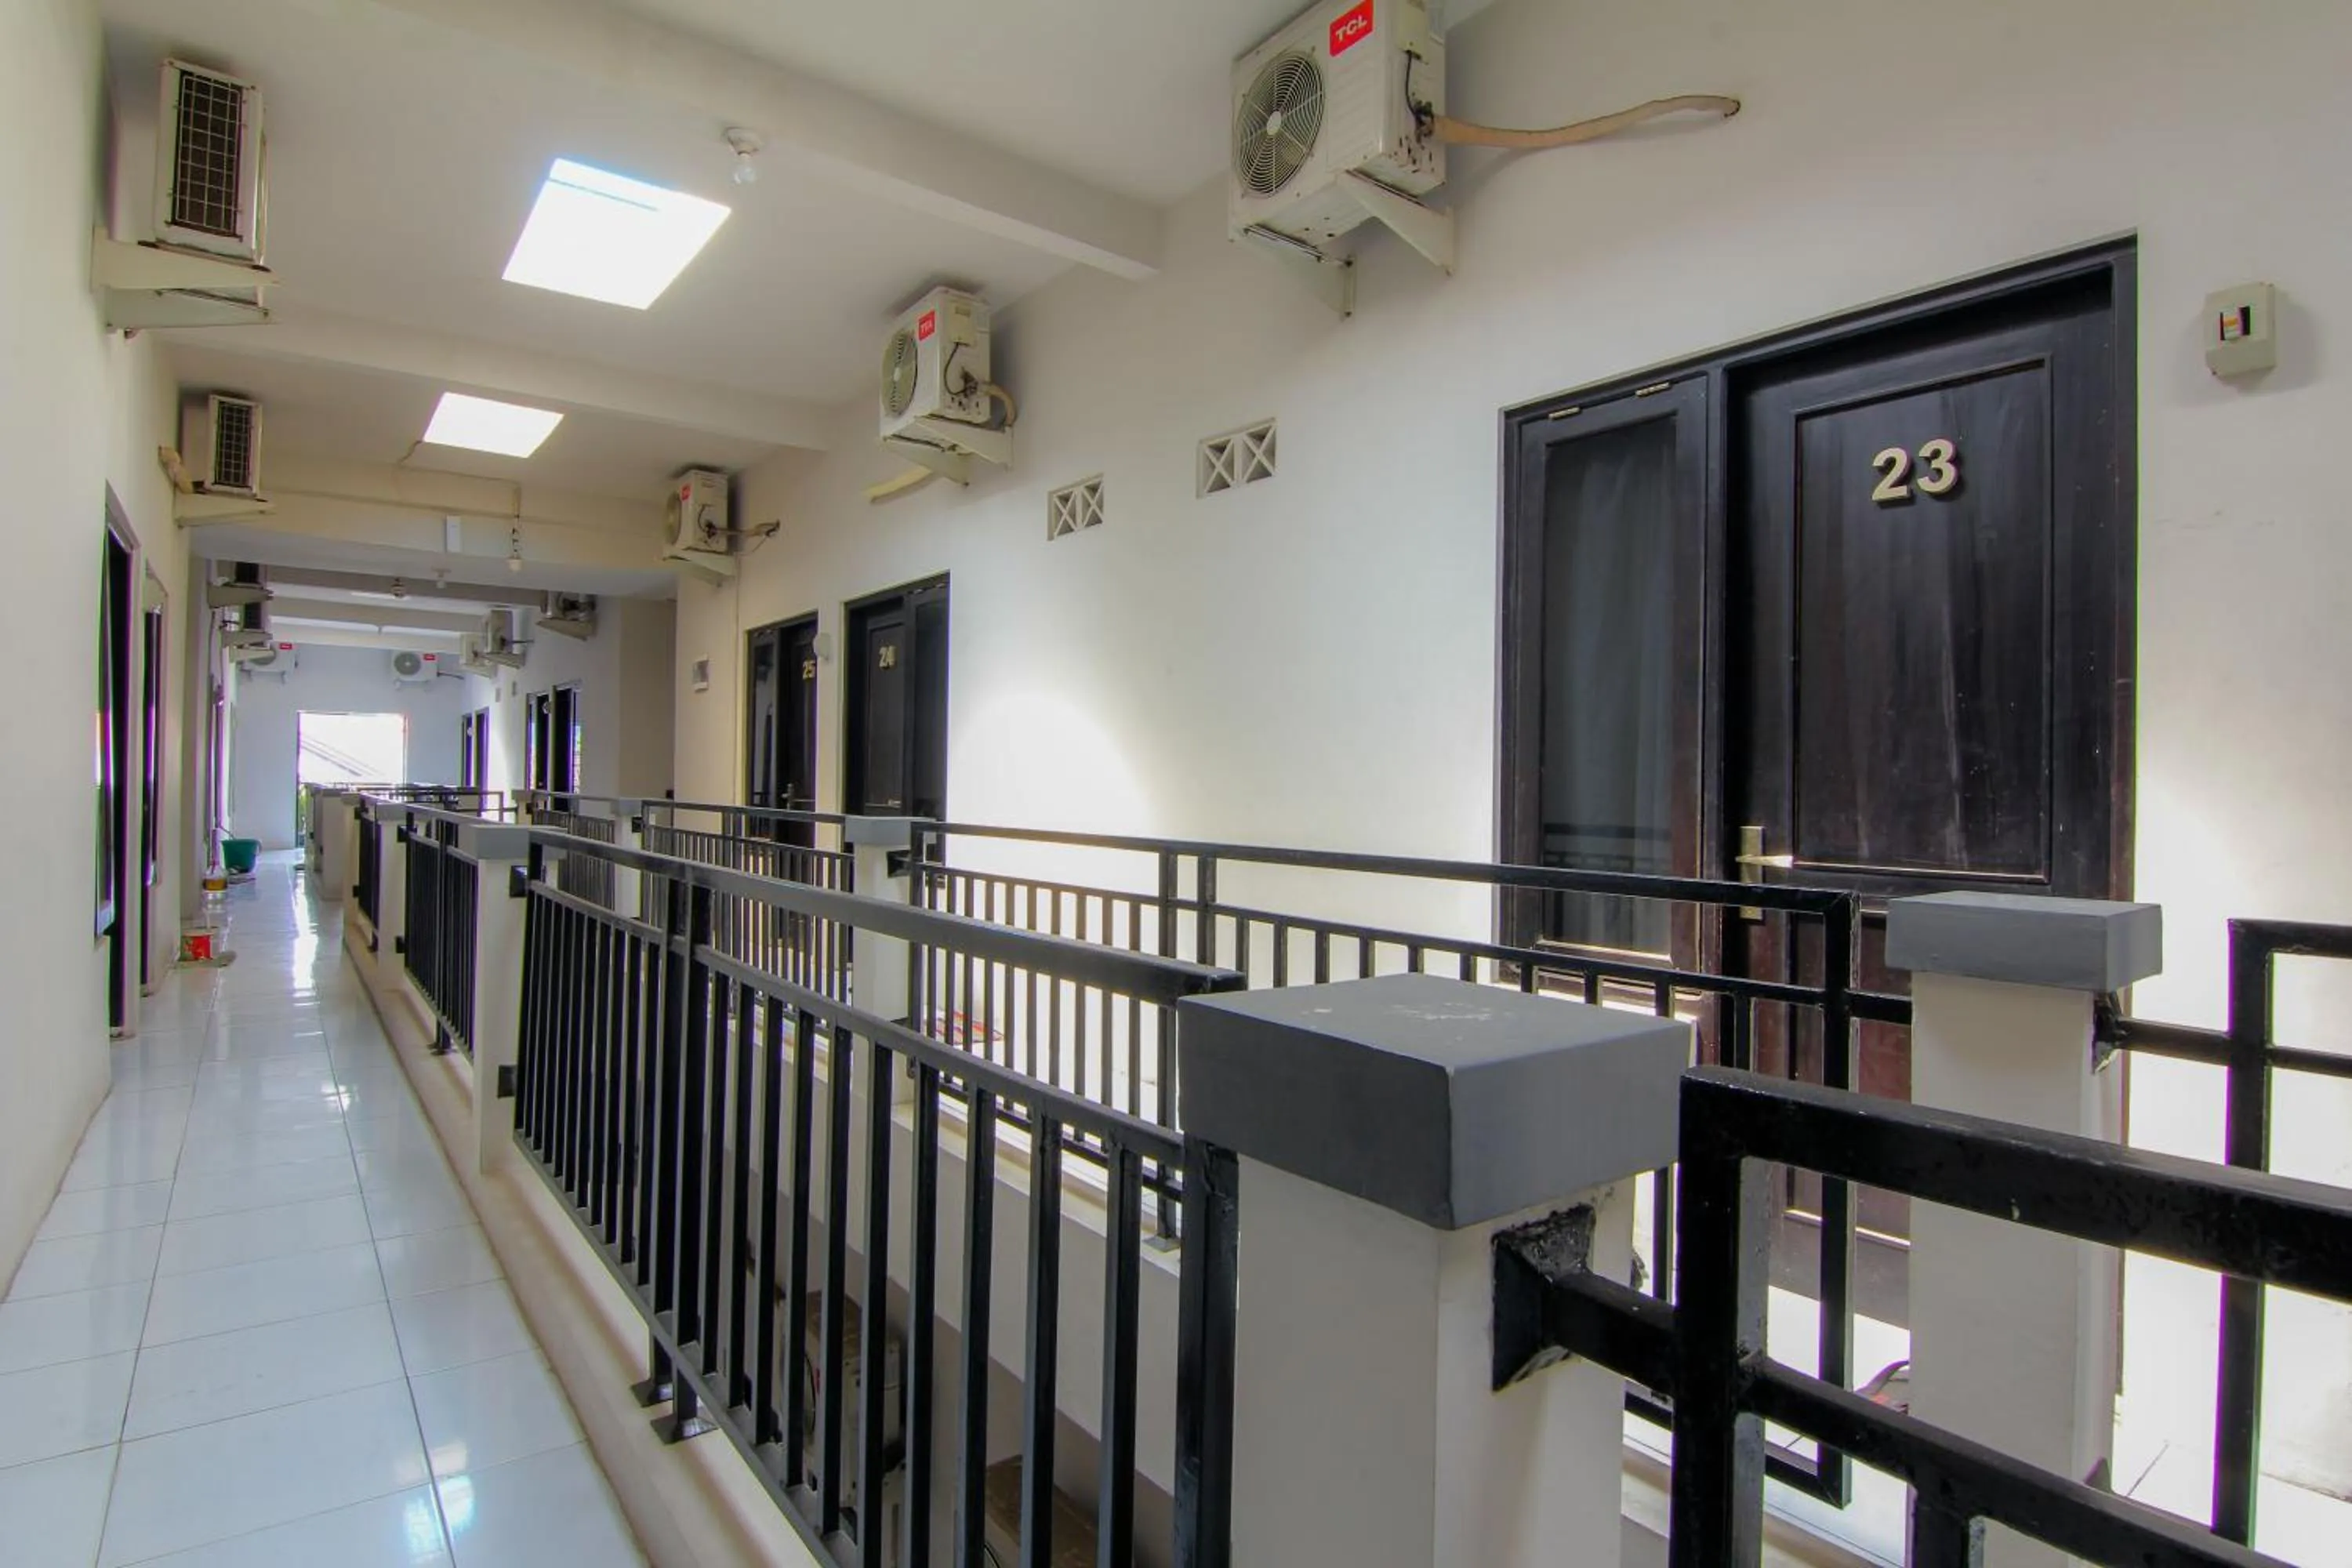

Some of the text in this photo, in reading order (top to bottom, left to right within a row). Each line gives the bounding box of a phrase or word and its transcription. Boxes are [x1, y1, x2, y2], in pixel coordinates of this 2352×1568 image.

[1336, 15, 1367, 42] TCL
[1871, 438, 1957, 501] 23
[879, 645, 897, 668] 24
[802, 659, 816, 680] 25
